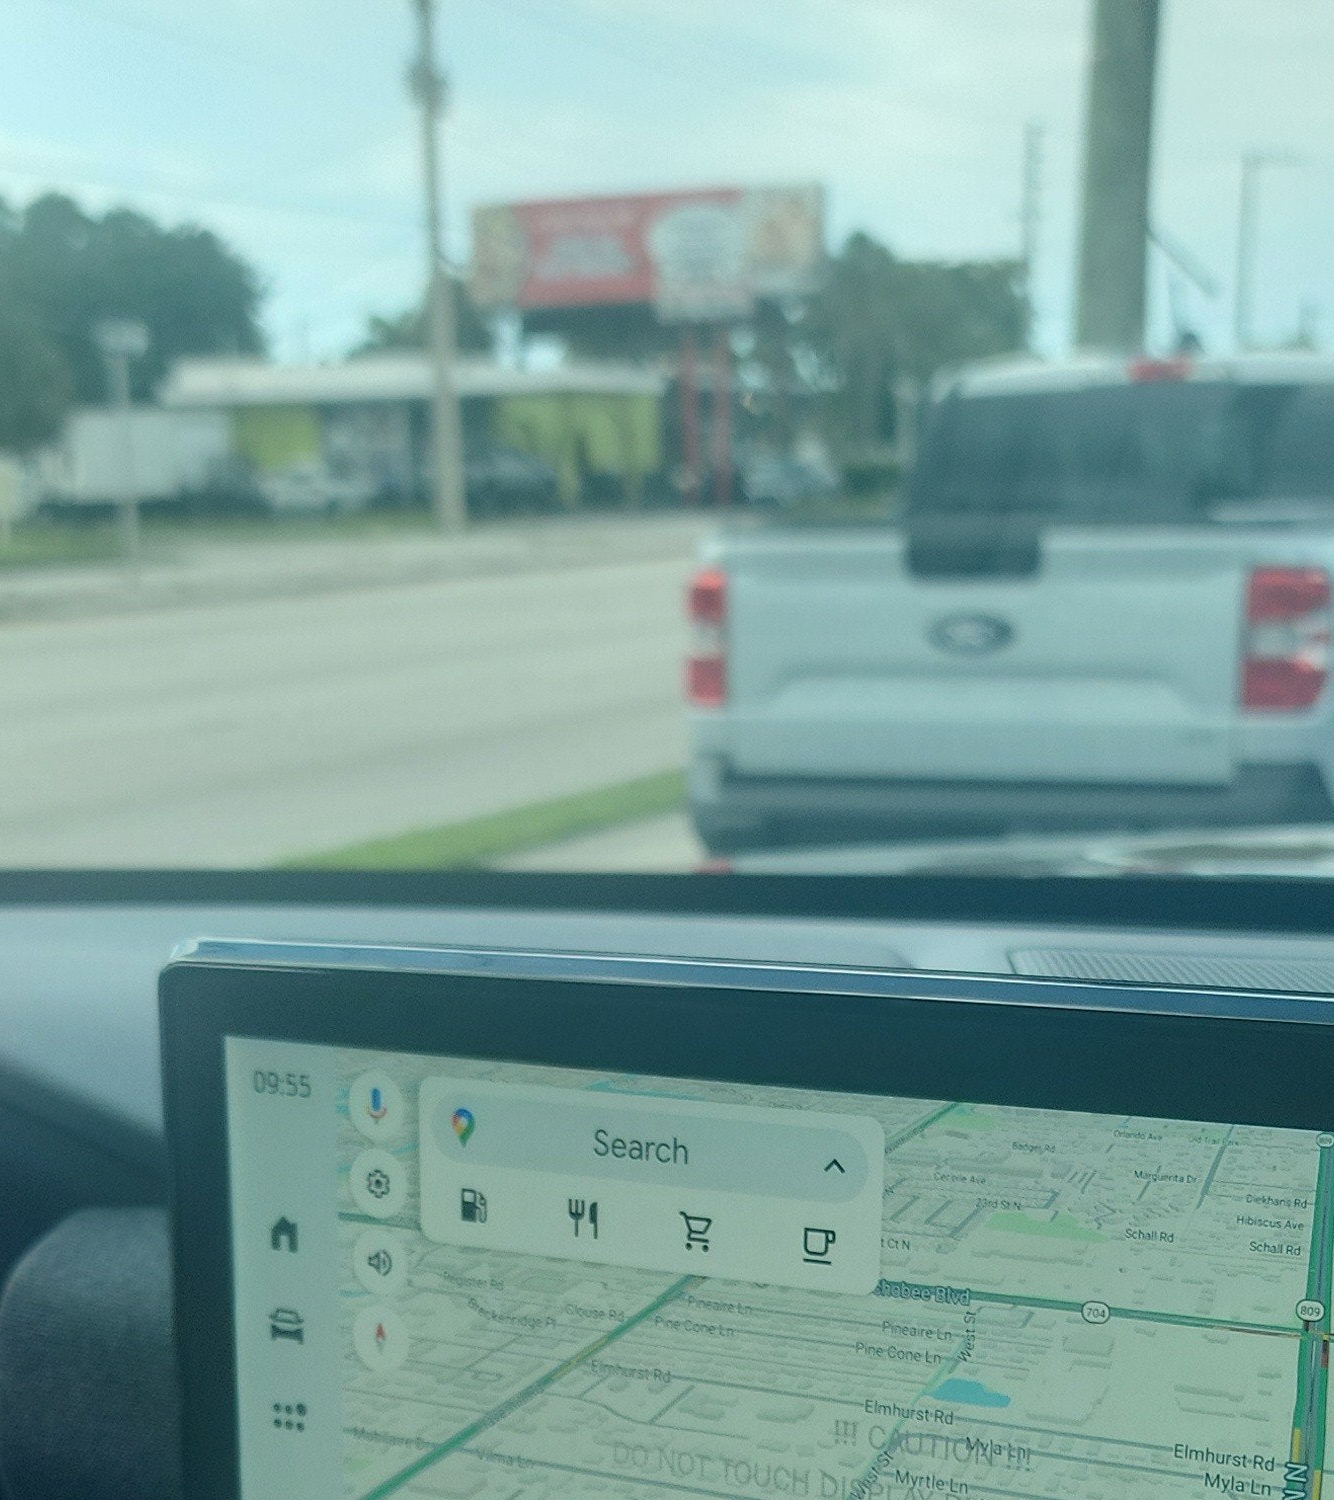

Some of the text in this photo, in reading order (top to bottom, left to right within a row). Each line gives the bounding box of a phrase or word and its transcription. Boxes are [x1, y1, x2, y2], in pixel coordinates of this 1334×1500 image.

[253, 1071, 312, 1099] 09:55
[593, 1129, 689, 1165] Search
[1186, 1175, 1198, 1184] Dr
[1294, 1199, 1308, 1209] Rd
[1236, 1214, 1305, 1231] Hibiscus Ave
[887, 1239, 899, 1250] Ct
[902, 1240, 911, 1251] N
[1125, 1228, 1175, 1243] Schall Rd
[1249, 1241, 1302, 1256] Schall Rd
[688, 1295, 753, 1315] Pineaire Ln
[934, 1285, 971, 1307] Blvd
[1085, 1306, 1106, 1319] 704
[1300, 1303, 1321, 1318] 809
[654, 1315, 736, 1338] Pine Cone Ln
[882, 1321, 952, 1341] Pineaire Ln
[957, 1311, 977, 1362] West St
[855, 1341, 942, 1364] Pine Cone Ln
[653, 1368, 671, 1384] Rd
[864, 1399, 954, 1426] Elmhurst Rd
[868, 1424, 994, 1467] CAUTION
[1173, 1443, 1275, 1472] Elmhurst Rd
[612, 1443, 653, 1471] DO
[659, 1447, 715, 1478] NOT
[720, 1458, 812, 1497] TOUCH
[1283, 1461, 1309, 1483] N
[894, 1469, 968, 1495] Myrtle Ln
[1204, 1472, 1272, 1497] Myla Ln
